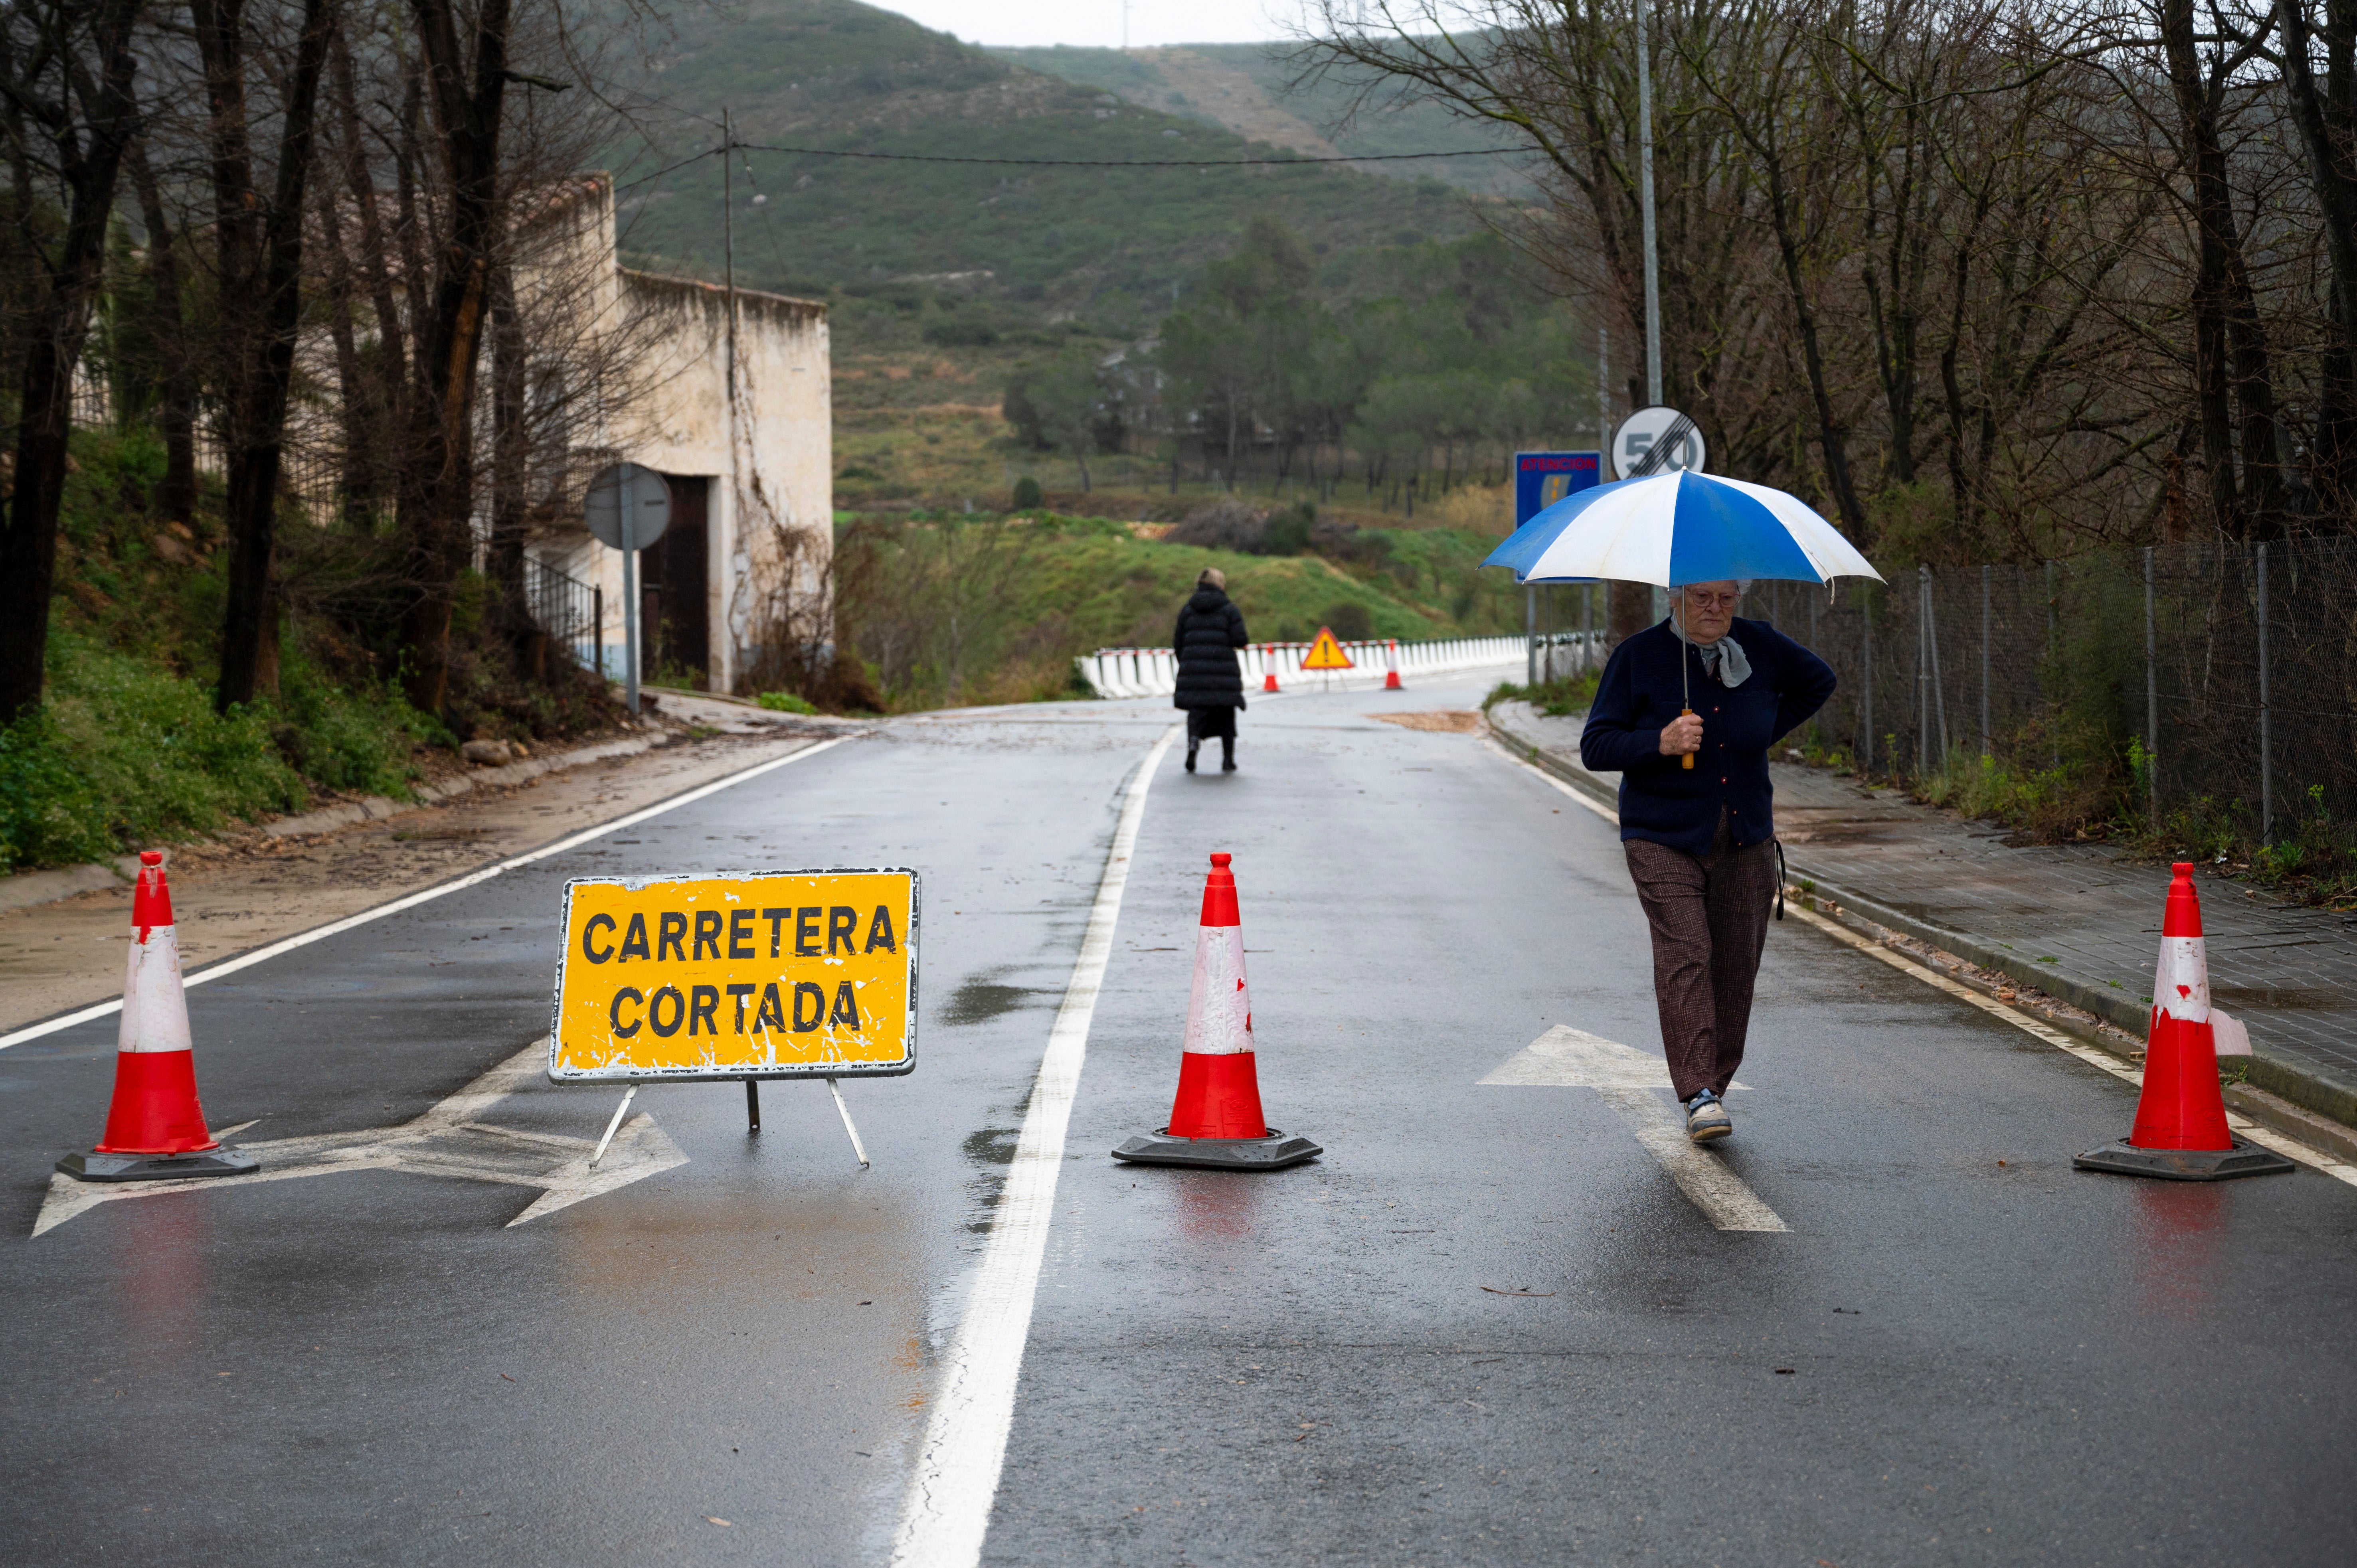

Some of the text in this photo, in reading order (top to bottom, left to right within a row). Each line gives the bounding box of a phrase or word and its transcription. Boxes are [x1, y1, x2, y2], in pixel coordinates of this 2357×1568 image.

[1626, 431, 1697, 472] 50
[582, 905, 897, 965] CARRETERA
[609, 980, 860, 1039] CORTADA
